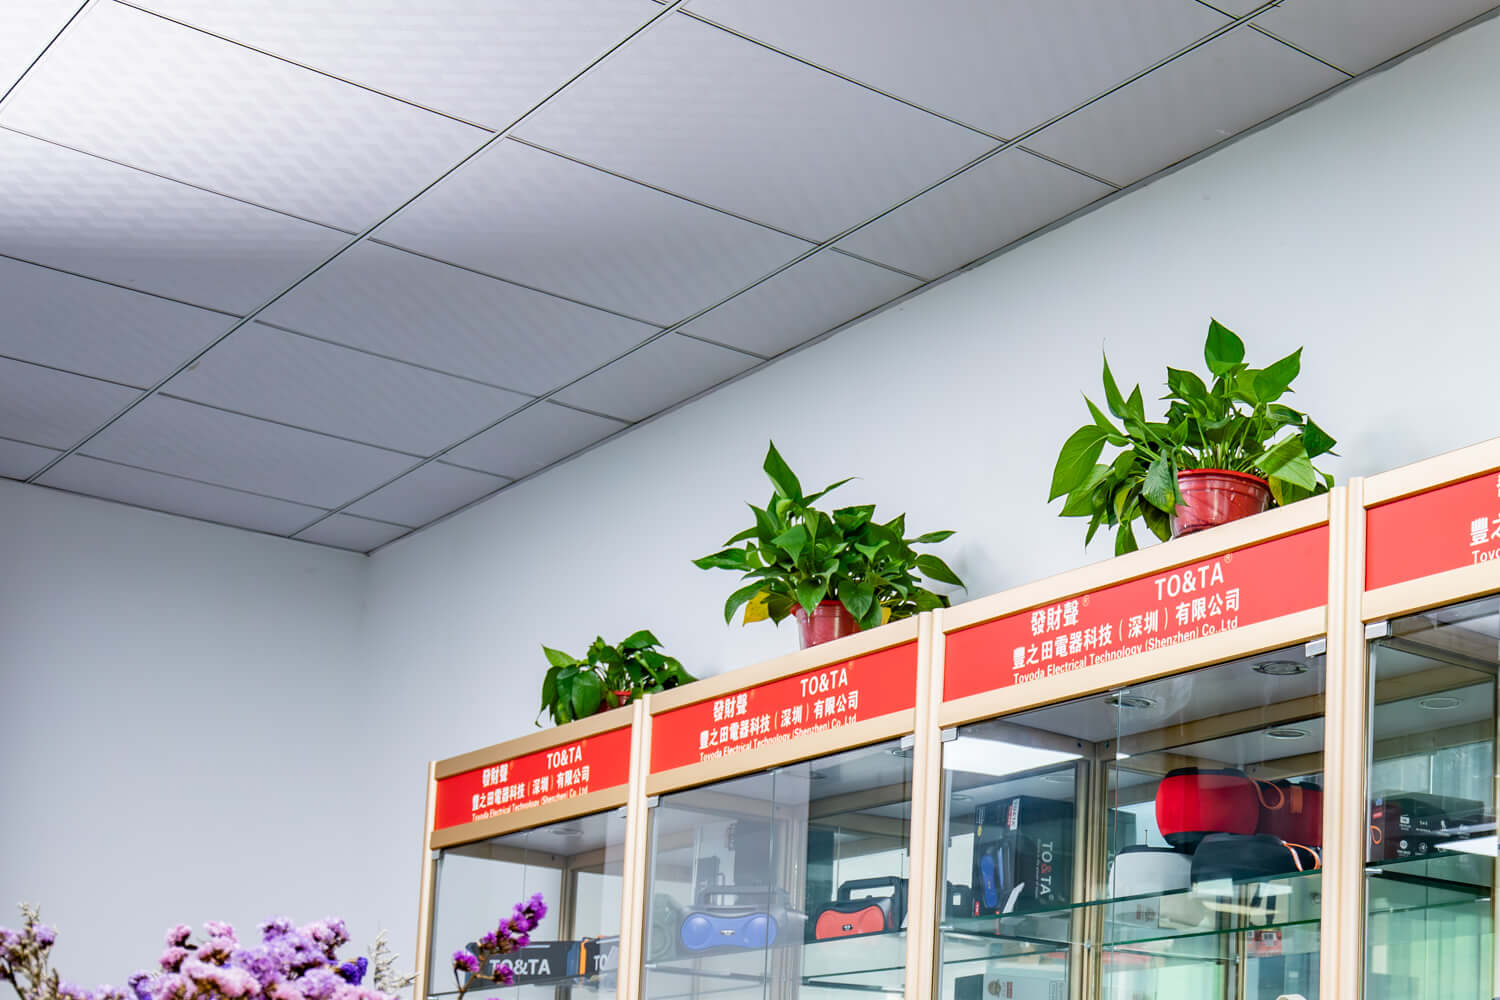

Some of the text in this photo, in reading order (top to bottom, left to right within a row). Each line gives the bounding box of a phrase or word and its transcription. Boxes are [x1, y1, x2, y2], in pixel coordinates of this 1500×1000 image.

[1154, 562, 1224, 601] TO&TA
[1031, 600, 1079, 637] 發財聲
[800, 668, 848, 698] TO&TA
[546, 745, 582, 770] TO&TA
[1040, 841, 1053, 895] TO&TA
[489, 958, 551, 976] TO&TA
